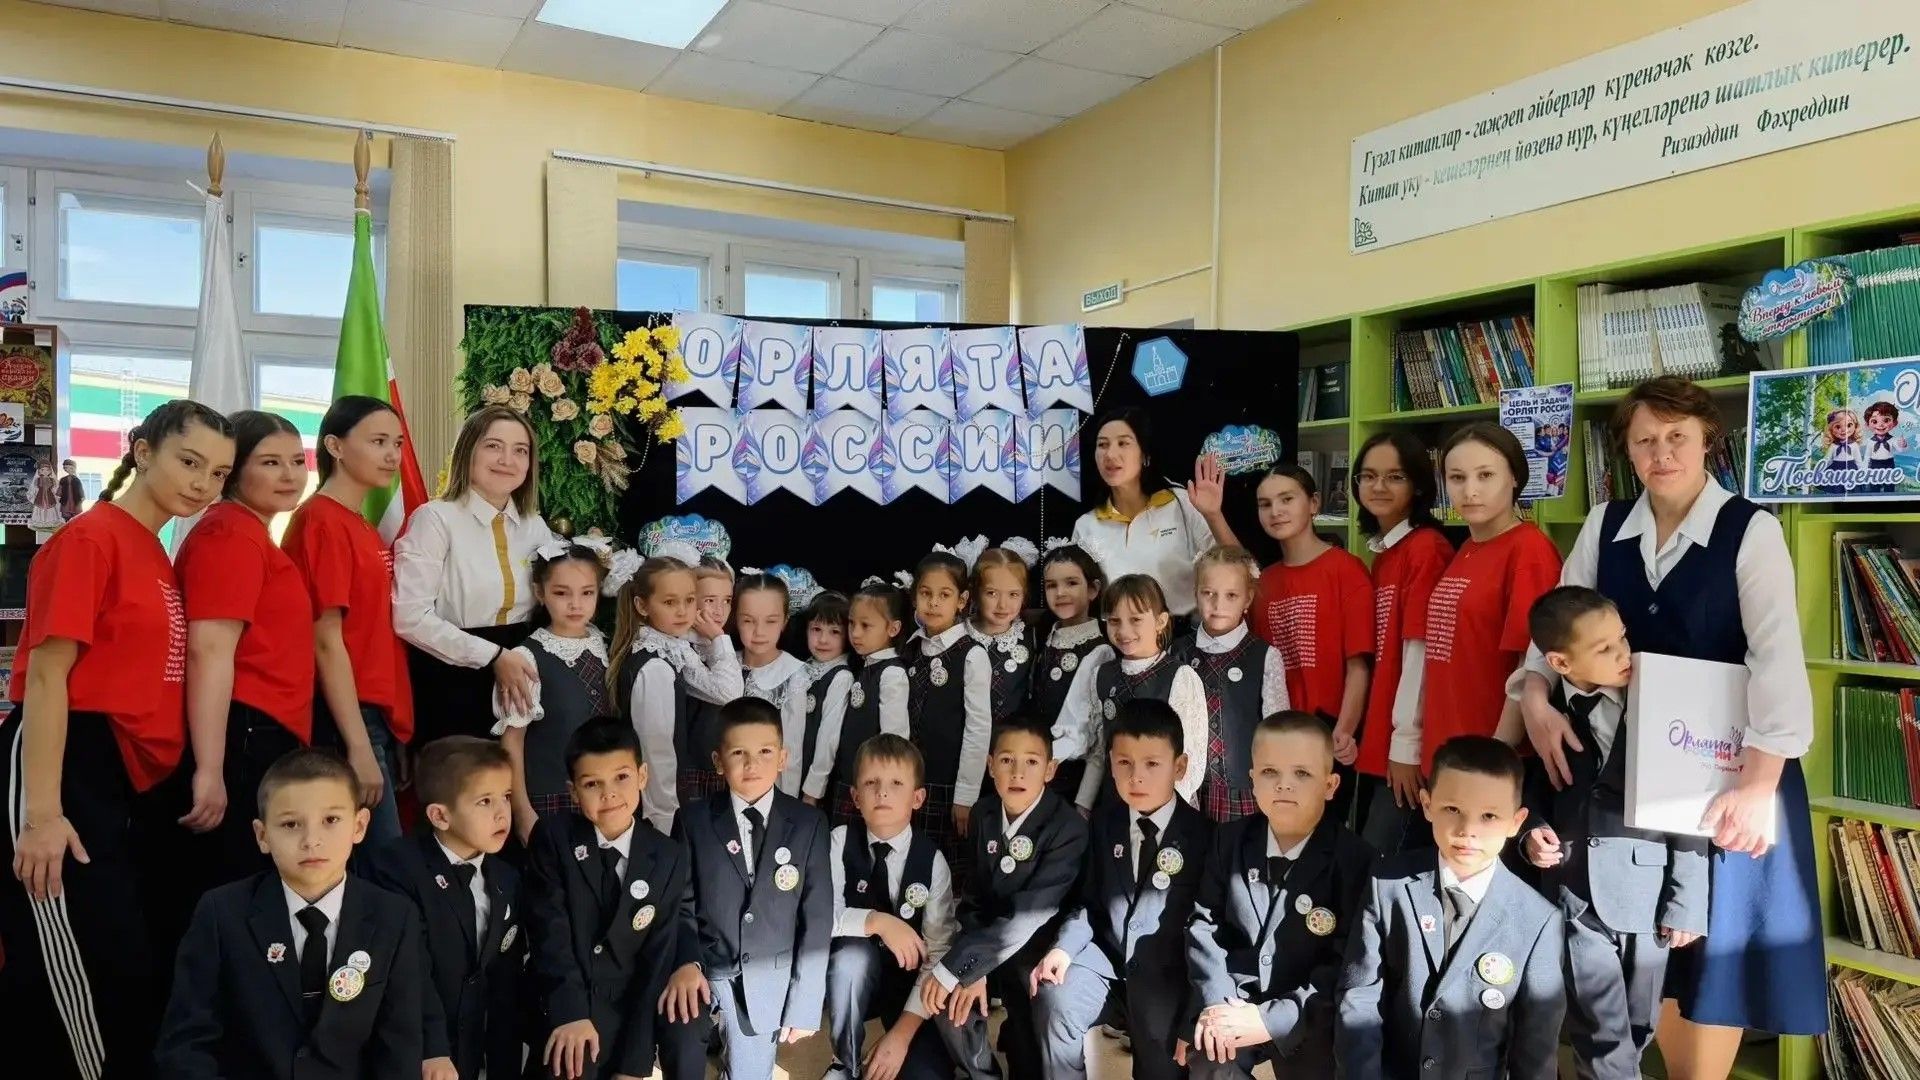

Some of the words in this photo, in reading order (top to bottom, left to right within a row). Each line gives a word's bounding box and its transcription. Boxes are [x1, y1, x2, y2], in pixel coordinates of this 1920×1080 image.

[1358, 181, 1399, 206] Китап
[1401, 175, 1422, 200] уку
[1515, 133, 1563, 163] йөзенә
[1566, 123, 1598, 152] нур,
[1602, 89, 1710, 141] күңелләренә
[1715, 60, 1804, 105] шатлык
[1808, 32, 1911, 79] китерер.
[1363, 149, 1395, 175] Гүзәл
[1399, 128, 1462, 162] китаплар
[1528, 84, 1596, 122] әйберләр
[1604, 51, 1694, 100] күренәчәк
[1704, 33, 1759, 67] көзге.
[1661, 122, 1739, 158] Ризаэддин
[1757, 93, 1850, 133] Фәхреддин
[1085, 286, 1117, 306] ВЫХОД
[683, 326, 1076, 392] ОРЛЯТА
[1509, 400, 1531, 408] ЦЕЛЬ
[1540, 396, 1567, 405] ЗАДАЧИ
[694, 423, 1066, 475] РОССИИ
[1765, 450, 1904, 491] Посвящение
